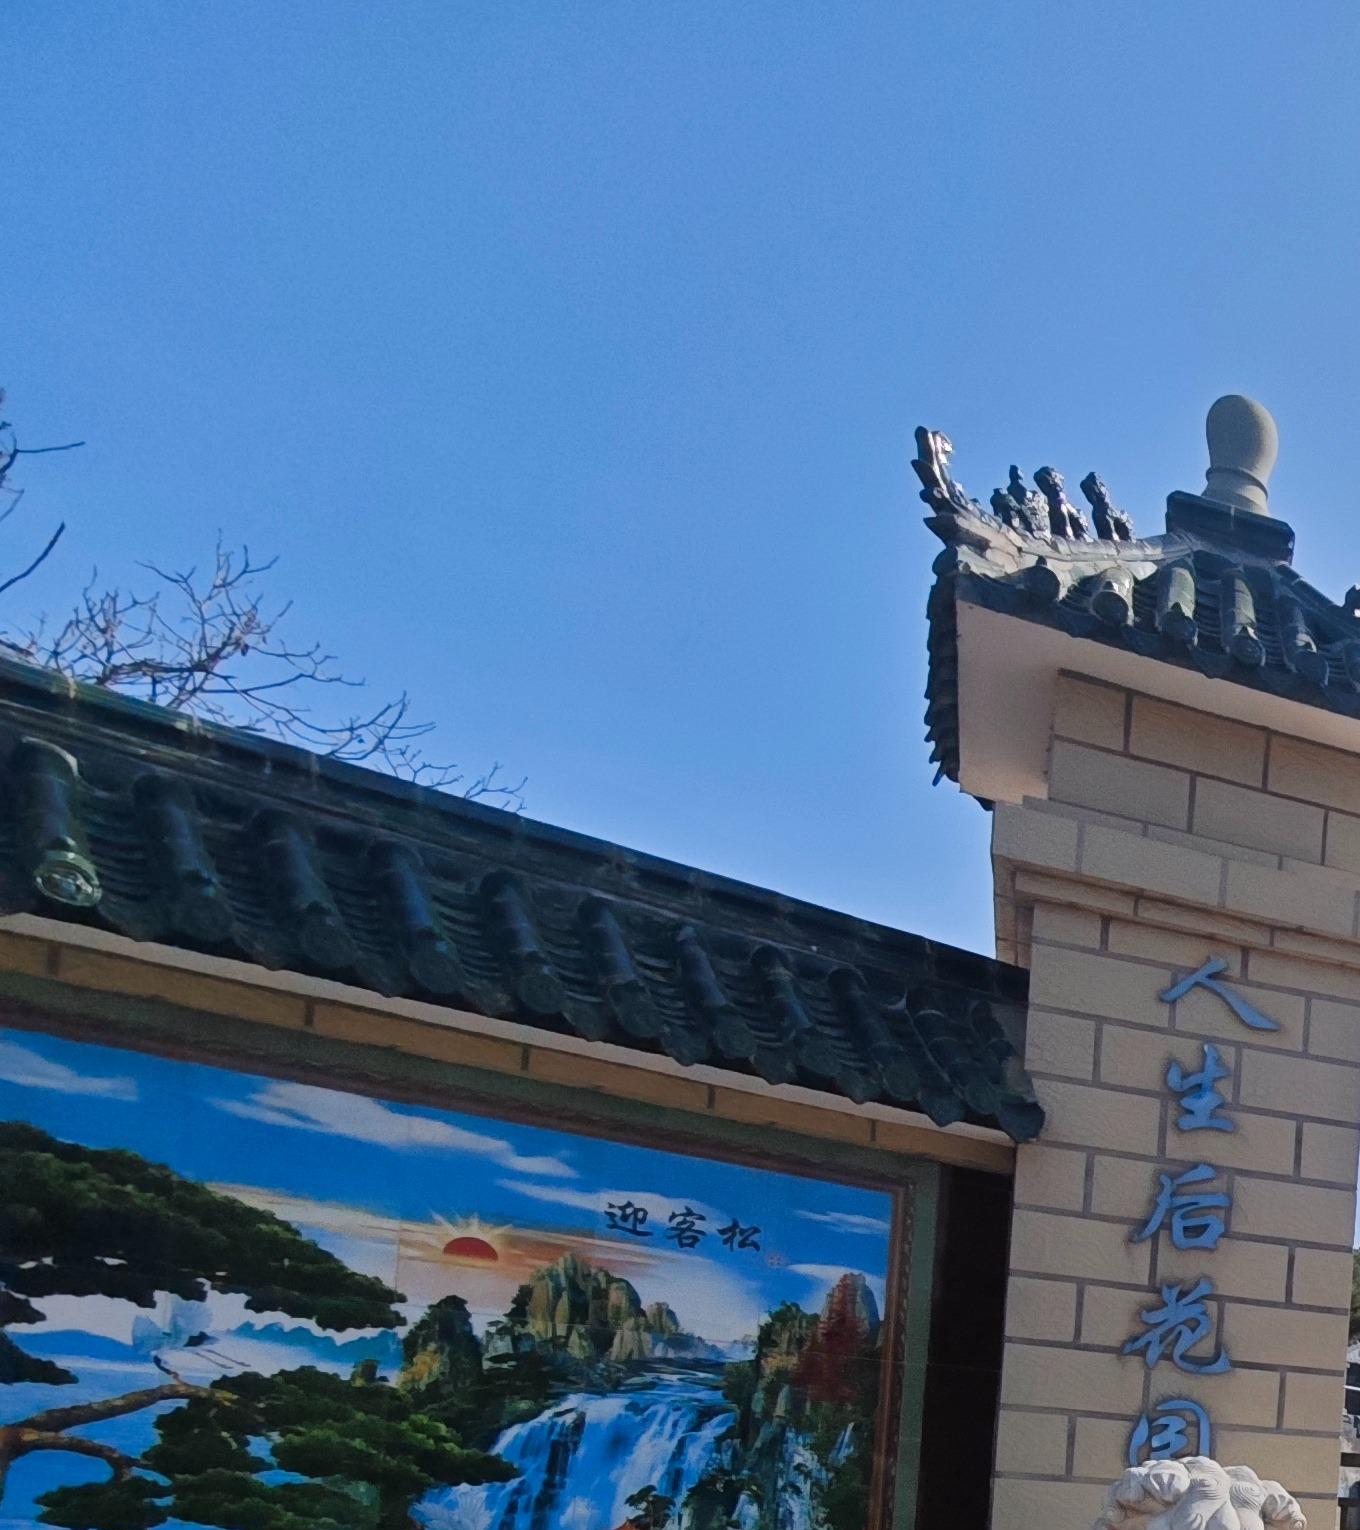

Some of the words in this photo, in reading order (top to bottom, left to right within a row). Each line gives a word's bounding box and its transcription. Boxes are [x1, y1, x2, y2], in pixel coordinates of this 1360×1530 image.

[603, 1200, 763, 1253] 迎客松
[1122, 956, 1282, 1467] 人生后花园
